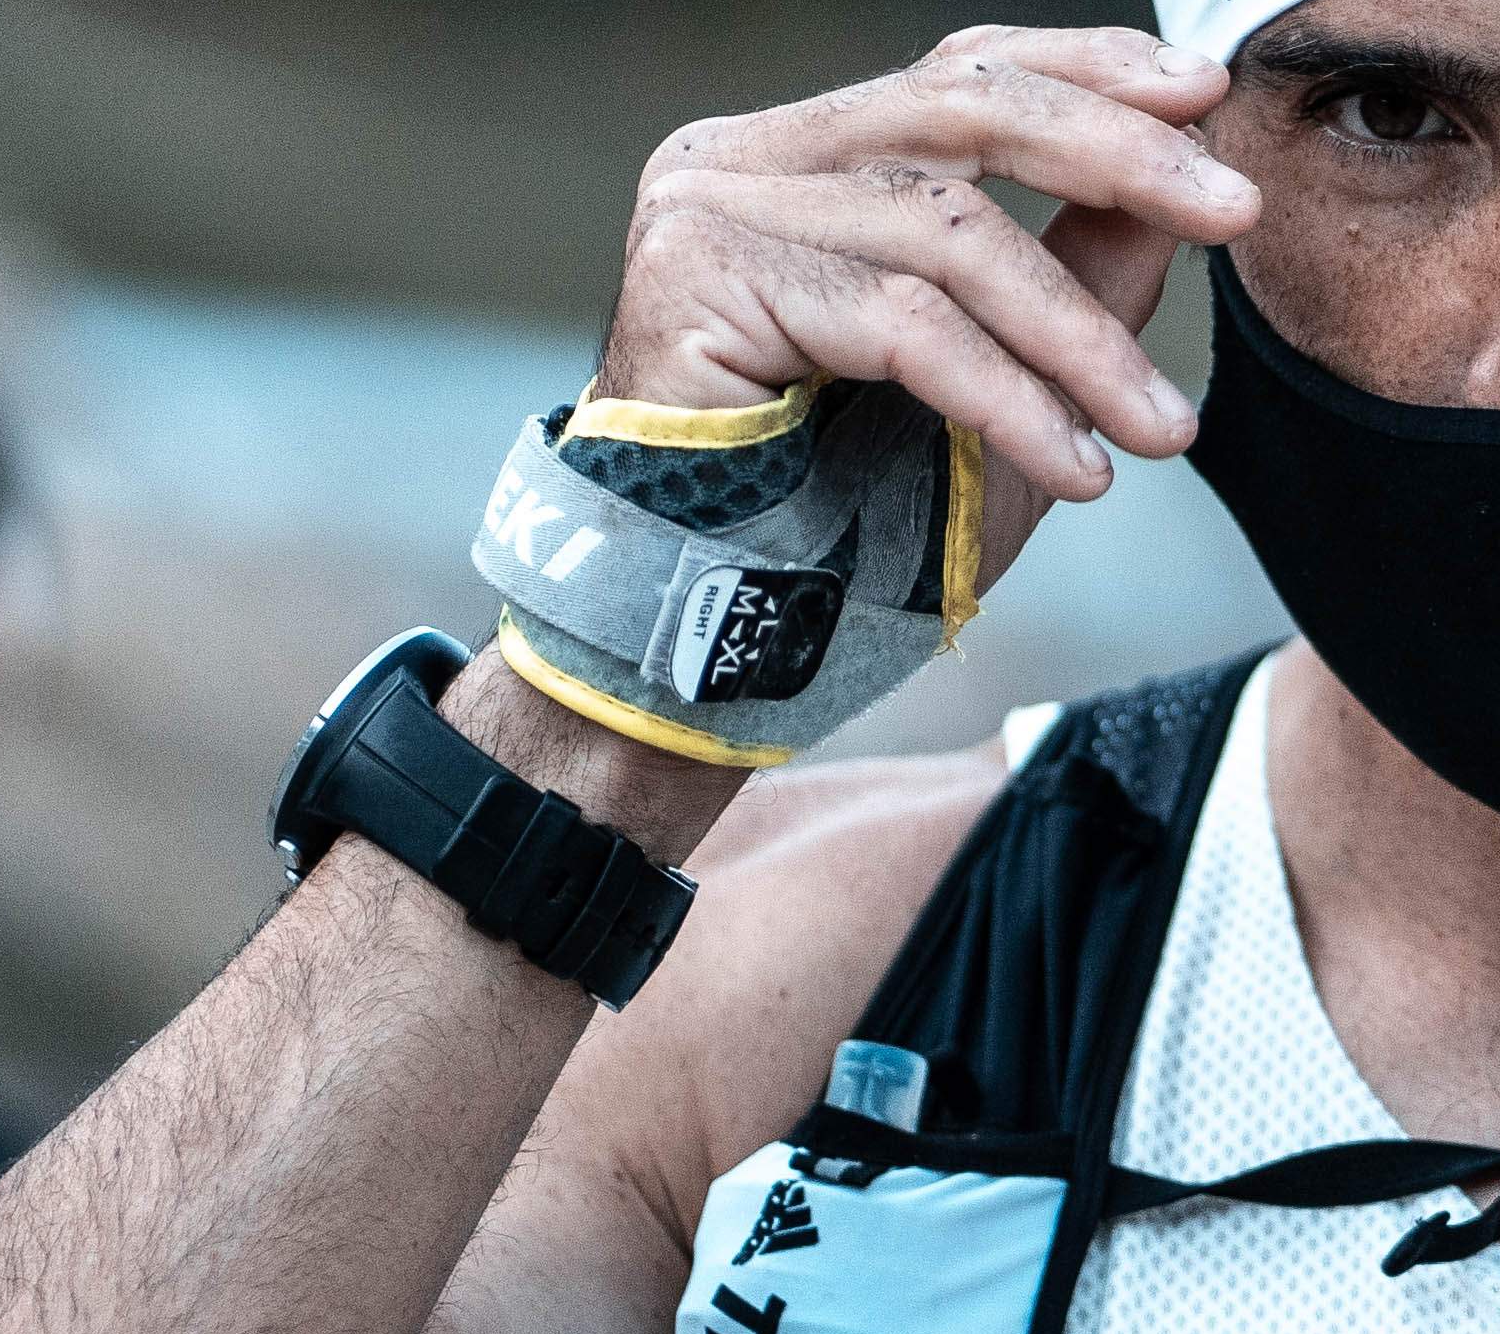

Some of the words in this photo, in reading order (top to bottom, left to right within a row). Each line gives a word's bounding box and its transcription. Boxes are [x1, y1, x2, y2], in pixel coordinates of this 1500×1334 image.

[693, 584, 720, 640] RIGHT
[730, 584, 764, 615] M
[710, 638, 747, 686] XL
